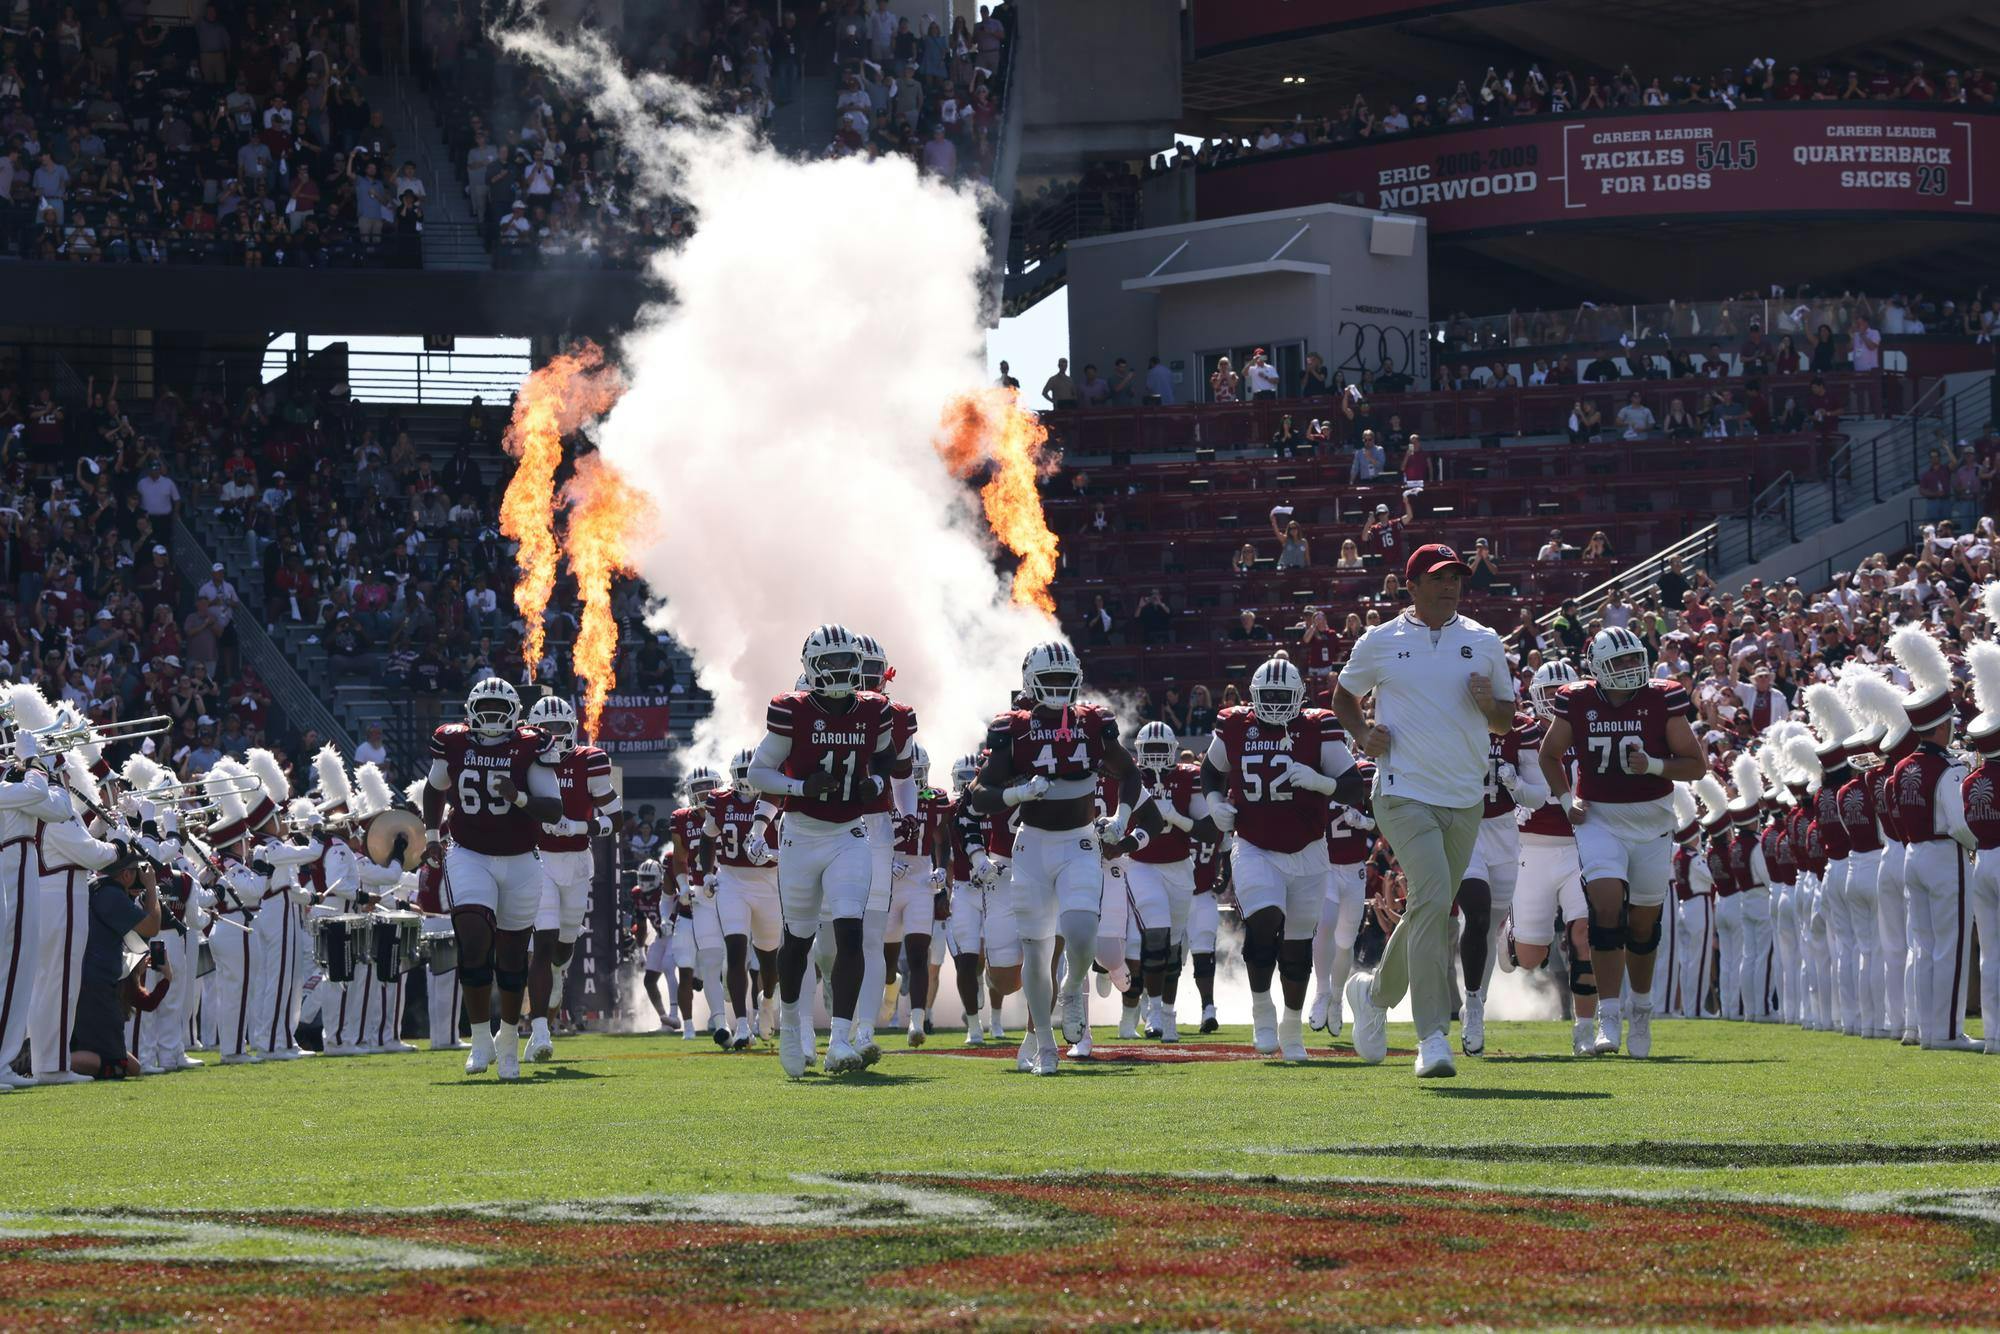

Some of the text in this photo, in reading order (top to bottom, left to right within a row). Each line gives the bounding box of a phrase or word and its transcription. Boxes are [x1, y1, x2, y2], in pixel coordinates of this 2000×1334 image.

[1593, 127, 1713, 144] CAREER LEADER
[1826, 126, 1936, 139] CAREER LEADER
[1378, 144, 1538, 186] ERIC 2006-2009
[1581, 140, 1758, 171] TACKLES 54.5
[1793, 146, 1951, 165] QUARTERBACK
[1379, 171, 1538, 210] NORWOOD
[1601, 173, 1712, 194] FOR LOSS
[1841, 165, 1948, 195] SACKS 29
[1382, 533, 1395, 548] 16
[811, 732, 866, 745] CAROLINA
[1589, 720, 1643, 733] CAROLINA
[1031, 742, 1091, 774] 44
[1244, 740, 1293, 752] CAROLIA
[1588, 735, 1645, 774] 70
[463, 756, 511, 768] CAROLINA
[820, 750, 856, 801] 11
[1241, 754, 1294, 802] 52
[458, 768, 512, 815] 65
